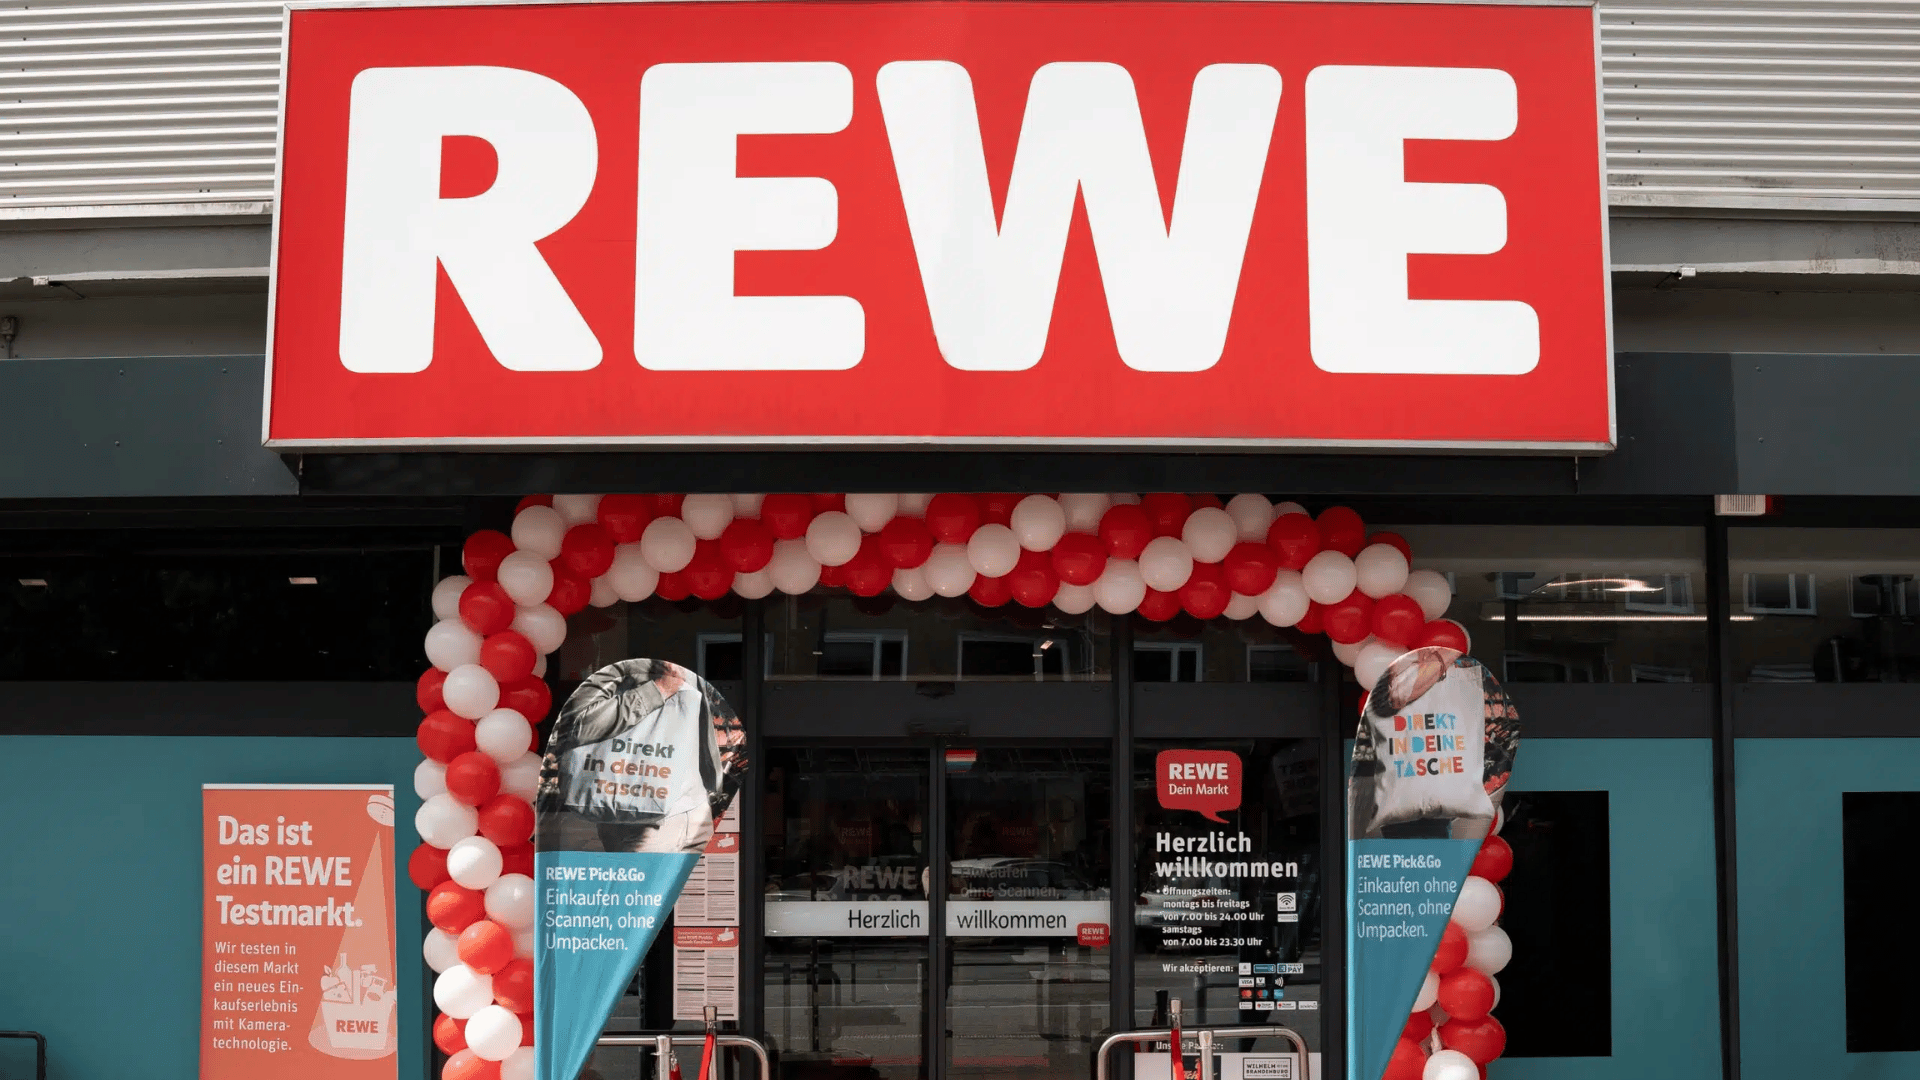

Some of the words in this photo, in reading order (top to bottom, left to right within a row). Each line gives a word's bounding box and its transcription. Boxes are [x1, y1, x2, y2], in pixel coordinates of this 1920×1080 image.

[338, 59, 1541, 375] REWE
[1393, 712, 1457, 732] DIREKT
[611, 738, 675, 759] Direkt
[1389, 736, 1408, 756] IN
[1411, 734, 1466, 754] DEINE
[583, 753, 605, 774] in
[610, 758, 672, 779] deine
[1169, 763, 1229, 780] REWE
[1393, 756, 1465, 778] TASCHE
[594, 778, 669, 800] Tasche
[1169, 783, 1194, 795] Dein
[1196, 783, 1229, 795] Markt
[218, 815, 270, 846] Das
[277, 815, 313, 846] ist
[1155, 831, 1251, 852] Herzlich
[216, 854, 257, 886] ein
[265, 856, 352, 887] REWE
[1155, 856, 1299, 878] willkommen
[1358, 855, 1391, 869] REWE
[1395, 855, 1441, 870] Pick&Go
[546, 867, 587, 882] REWE
[589, 867, 645, 882] Pick&Go
[960, 881, 993, 897] ohne
[1162, 885, 1231, 898] Öffnungszeiten:
[1358, 876, 1420, 894] Einkaufen
[1424, 877, 1457, 894] ohne
[546, 888, 620, 907] Einkaufen
[625, 891, 662, 907] ohne
[1163, 900, 1200, 910] montags
[1202, 899, 1215, 909] bis
[1217, 899, 1250, 909] freitags
[215, 895, 363, 928] Testmarkt.
[1163, 913, 1179, 921] von
[1181, 912, 1202, 921] 7.00
[1204, 912, 1218, 921] bis
[1219, 912, 1247, 921] 24.00
[1249, 912, 1265, 921] Uhr
[1358, 898, 1415, 918] Scannen,
[1418, 900, 1451, 916] ohne
[546, 910, 613, 931] Scannen,
[618, 912, 655, 929] ohne
[848, 909, 921, 929] Herzlich
[956, 909, 1067, 929] willkommen
[1082, 927, 1105, 935] REWE
[1162, 925, 1202, 935] samstags
[1357, 920, 1428, 941] Umpacken.
[215, 941, 236, 954] Wir
[240, 942, 280, 955] testen
[284, 941, 296, 955] in
[546, 933, 628, 953] Umpacken.
[1162, 938, 1179, 946] von
[1181, 938, 1202, 946] 7.00
[1204, 937, 1218, 946] bis
[1219, 938, 1245, 947] 23.30
[1247, 937, 1263, 946] Uhr
[214, 960, 259, 973] diesem
[263, 961, 299, 974] Markt
[1162, 963, 1178, 972] Wir
[1179, 963, 1234, 975] akzeptieren:
[213, 980, 233, 992] ein
[238, 981, 275, 993] neues
[279, 980, 304, 994] Ein-
[213, 998, 298, 1013] kaufserlebnis
[213, 1018, 234, 1031] mit
[239, 1018, 290, 1032] Kamera-
[336, 1019, 379, 1034] REWE
[213, 1037, 292, 1053] technologie.
[1156, 1041, 1186, 1050] Unse
